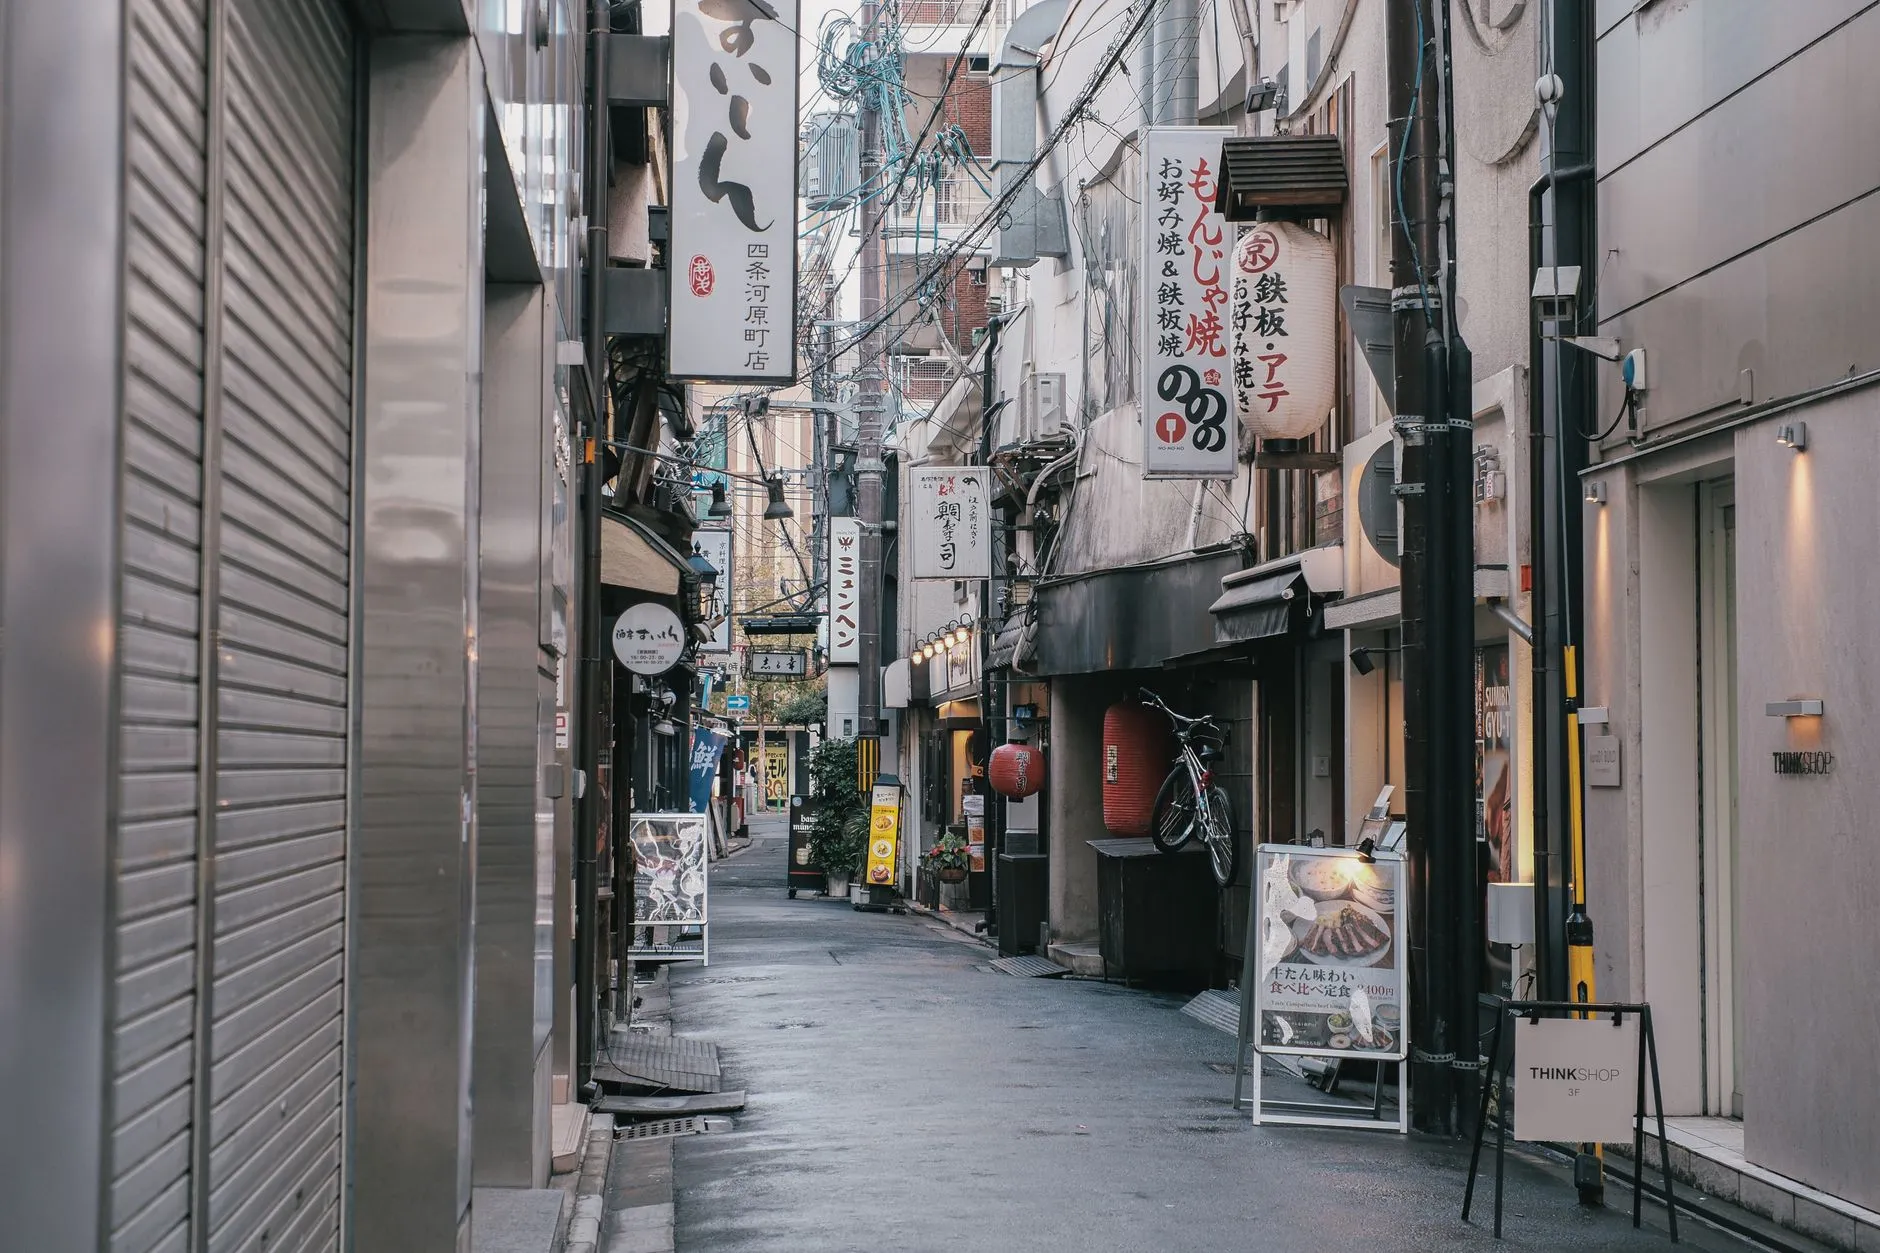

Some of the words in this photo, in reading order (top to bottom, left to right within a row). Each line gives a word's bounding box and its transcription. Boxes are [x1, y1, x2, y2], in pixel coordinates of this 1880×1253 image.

[1185, 157, 1228, 358] もんじゃ焼
[743, 243, 770, 372] 四条河原町店
[835, 556, 856, 648] ミュンヘン
[1773, 751, 1832, 775] THINKSHOP
[1270, 981, 1351, 998] 食べ比べ定食
[1529, 1067, 1620, 1082] THINKSHOP
[1568, 1088, 1580, 1097] 3F
